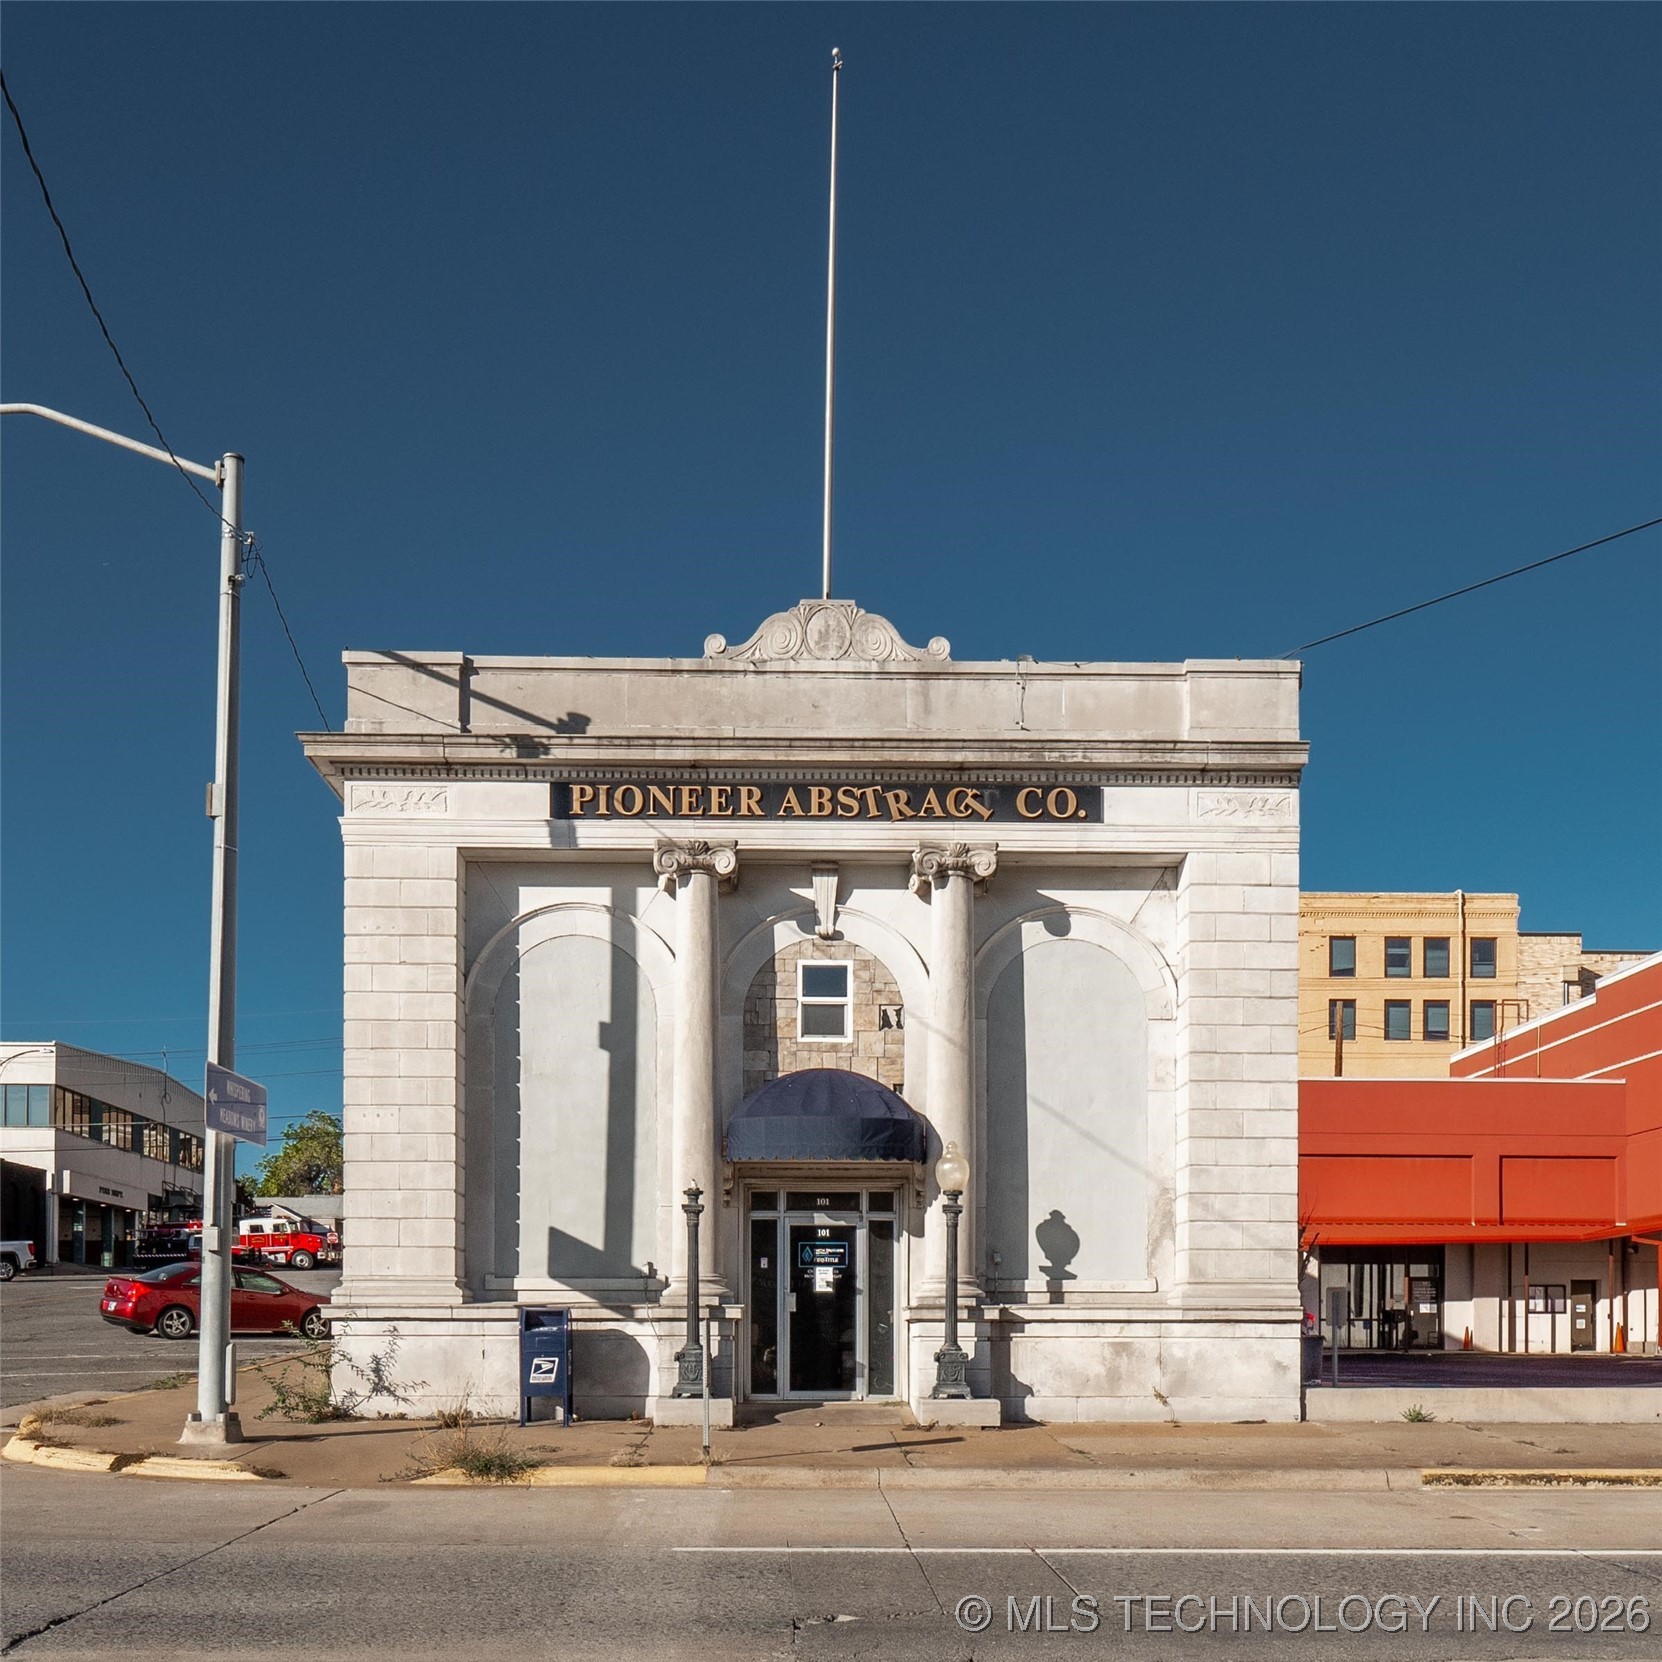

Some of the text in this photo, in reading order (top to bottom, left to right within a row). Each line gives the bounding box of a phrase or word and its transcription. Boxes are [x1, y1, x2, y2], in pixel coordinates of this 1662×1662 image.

[568, 784, 766, 817] PIONEER
[1015, 786, 1087, 818] CO.
[816, 1198, 830, 1206] 101
[817, 1229, 831, 1237] 101
